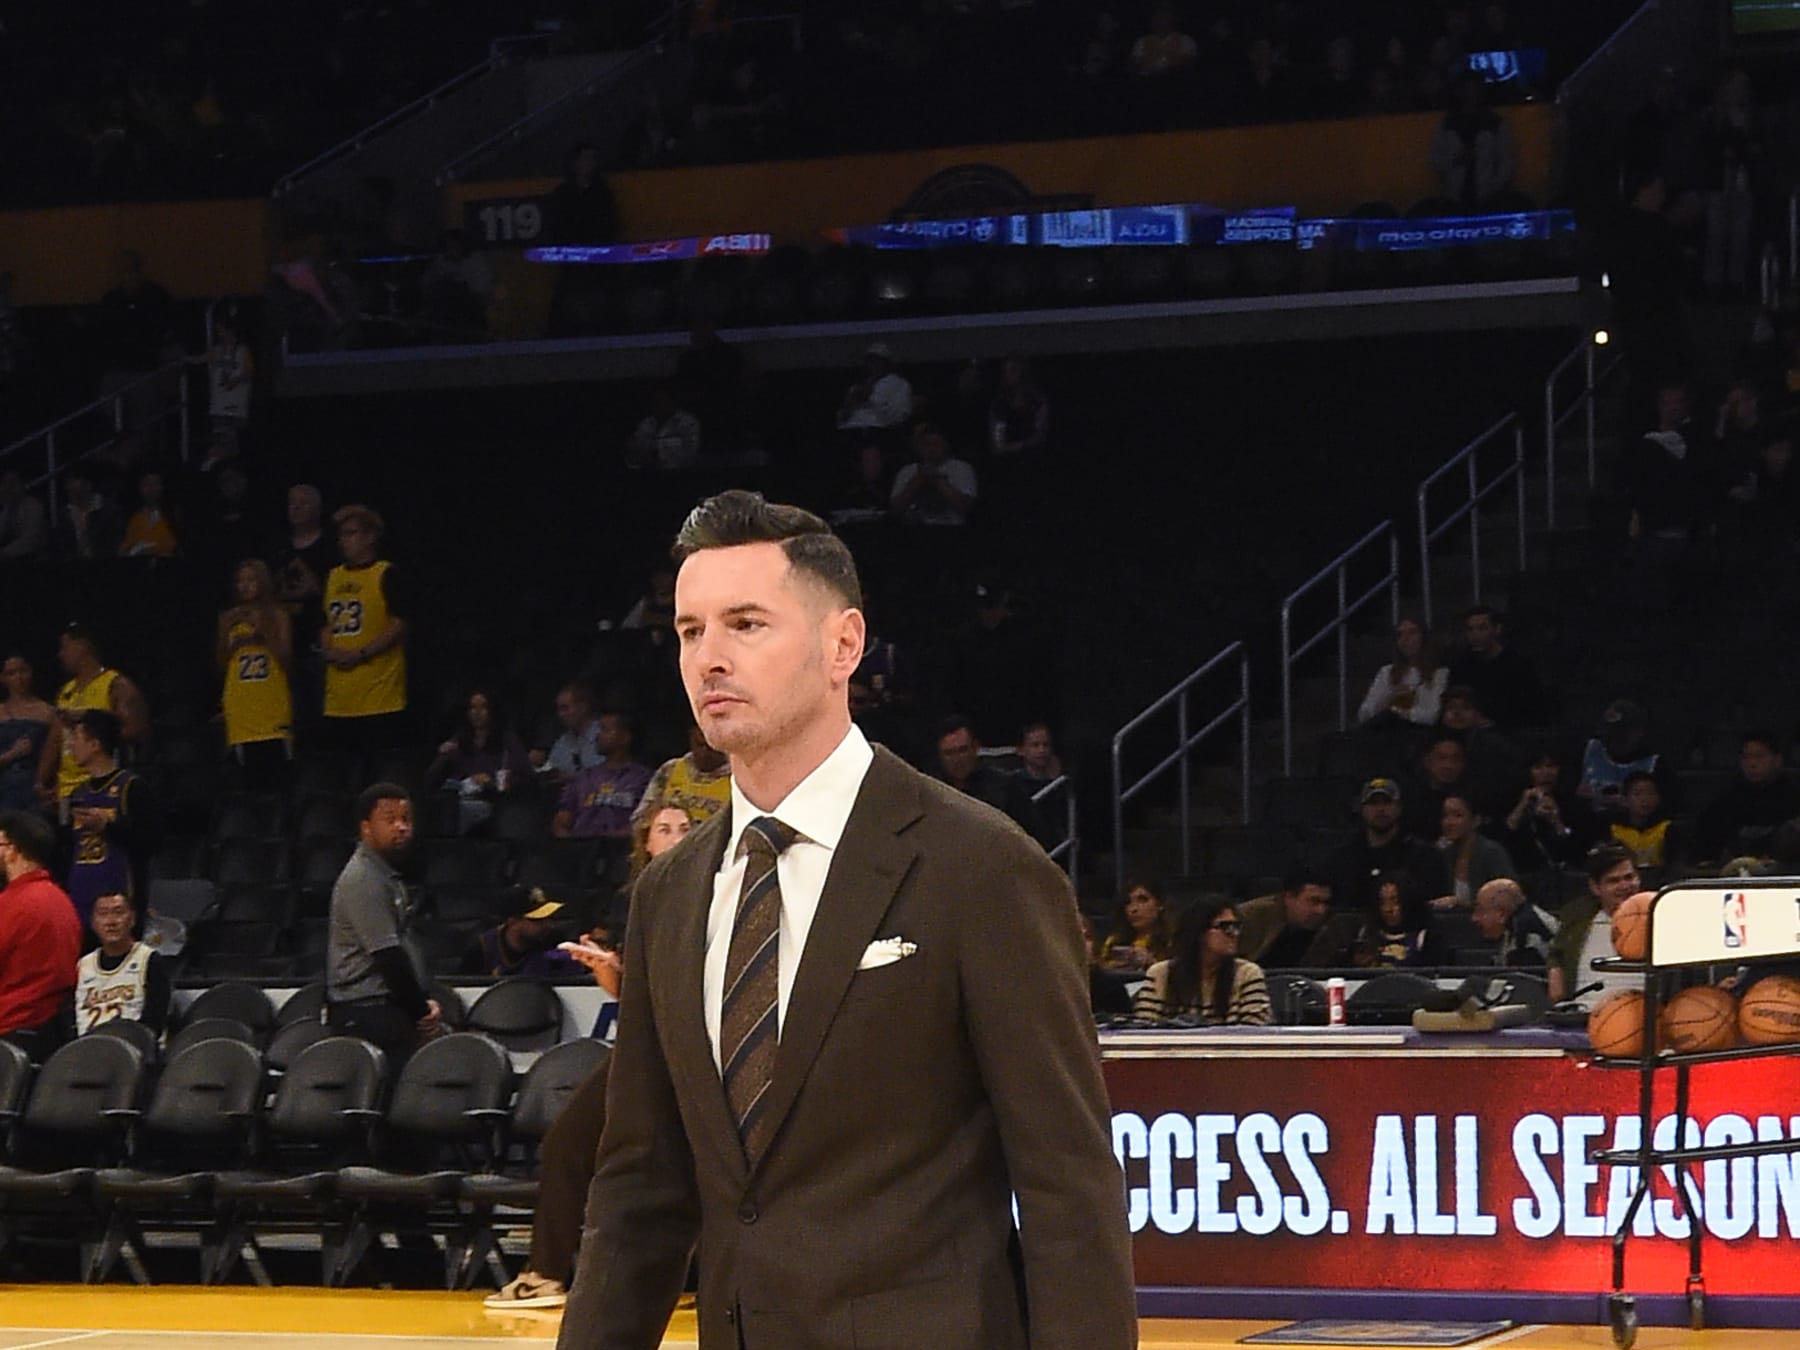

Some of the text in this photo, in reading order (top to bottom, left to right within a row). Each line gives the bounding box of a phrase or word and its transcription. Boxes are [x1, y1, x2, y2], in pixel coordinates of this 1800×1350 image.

[480, 204, 542, 240] 119
[327, 597, 365, 637] 23
[238, 653, 271, 682] 23
[1365, 1113, 1498, 1236] ALL
